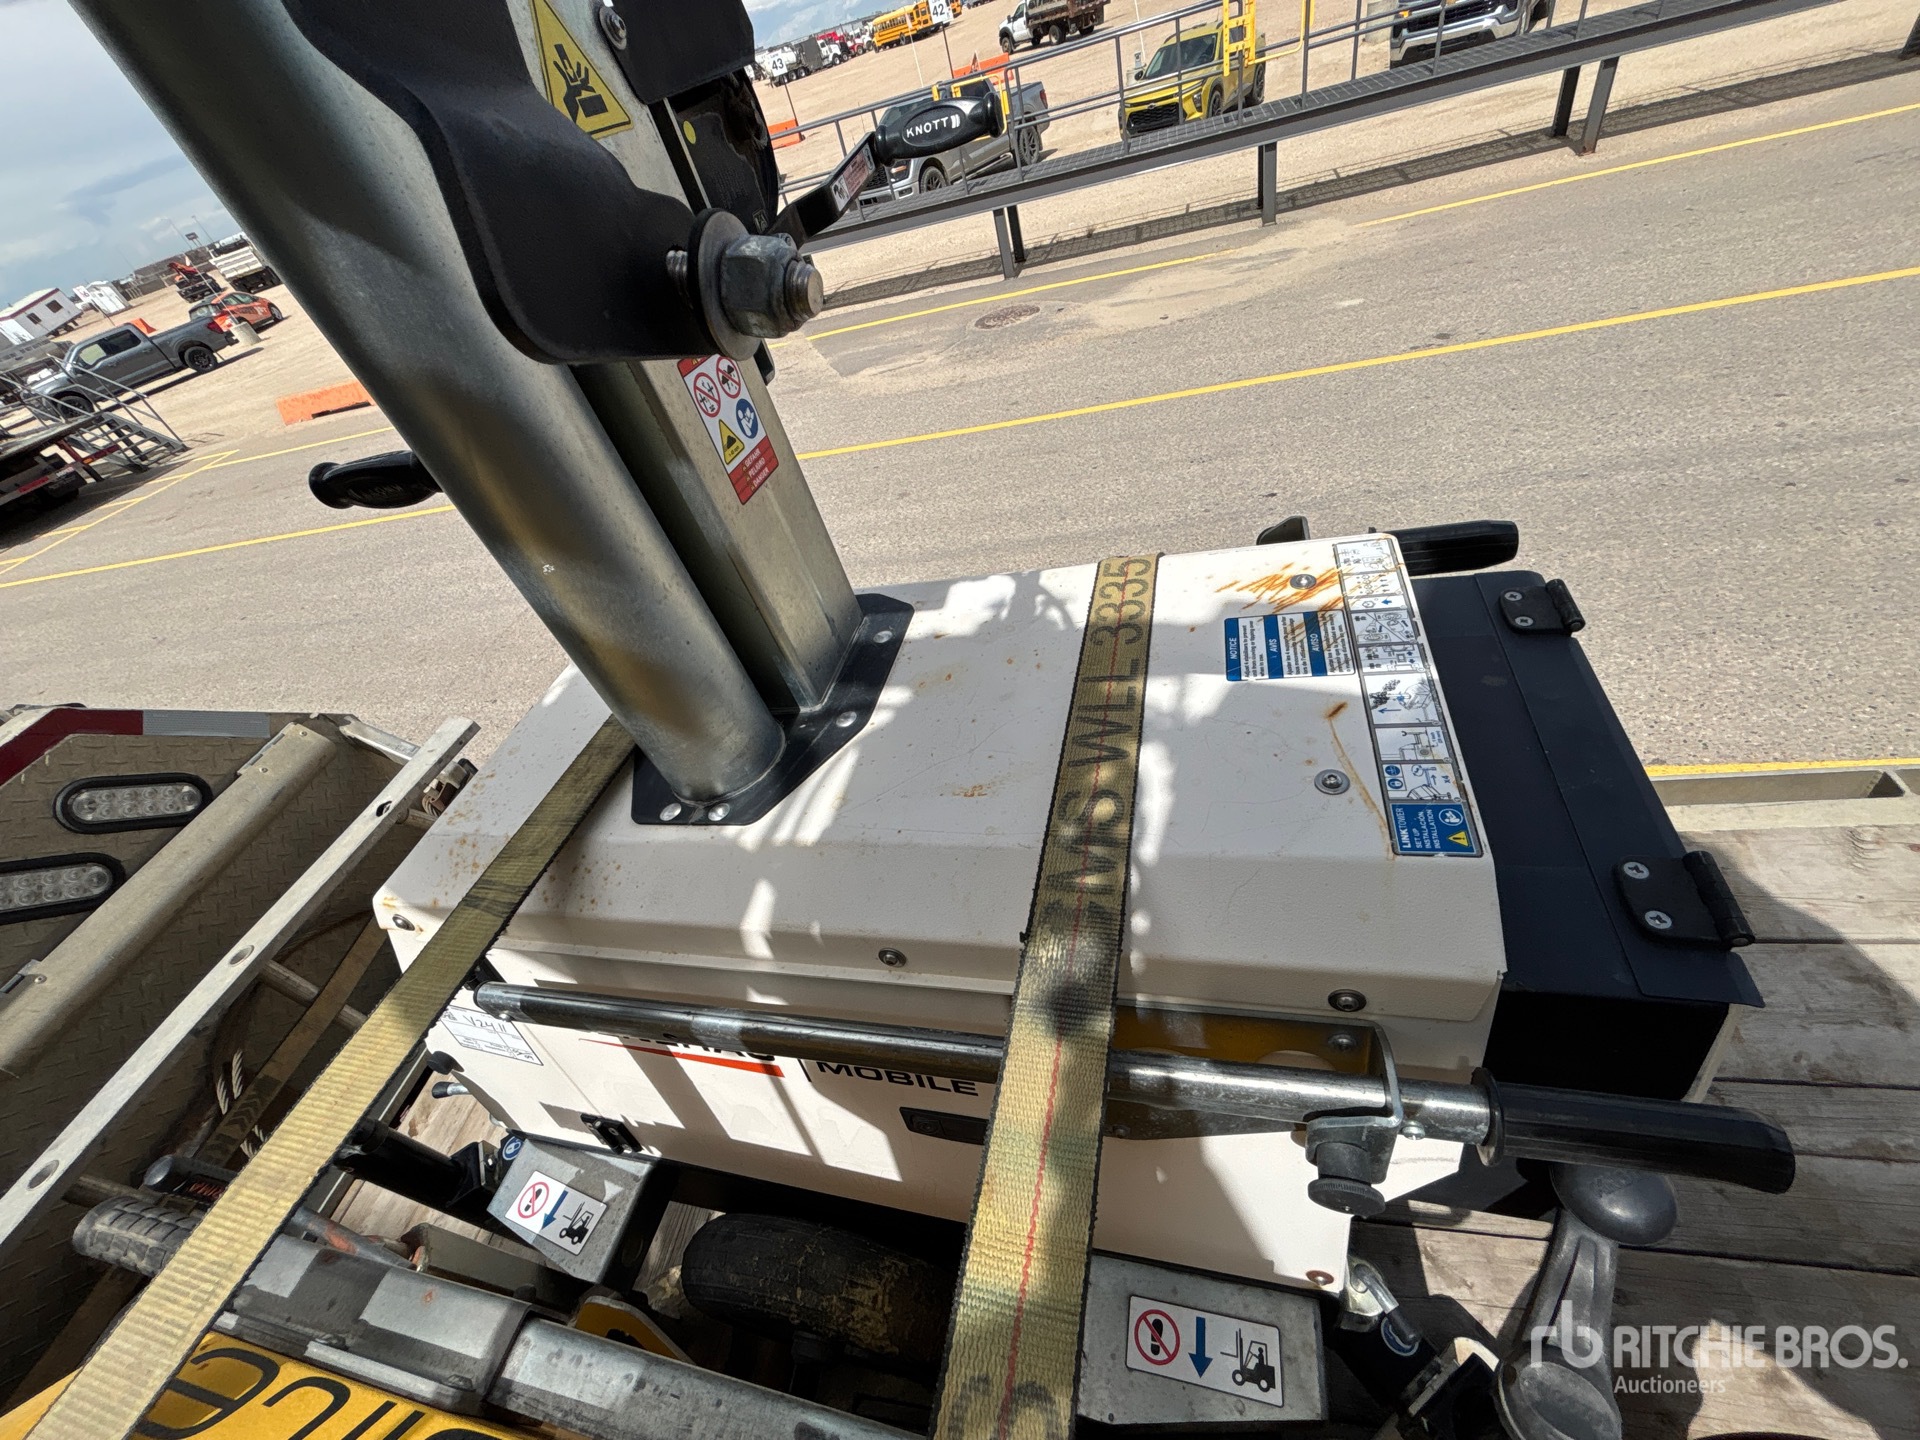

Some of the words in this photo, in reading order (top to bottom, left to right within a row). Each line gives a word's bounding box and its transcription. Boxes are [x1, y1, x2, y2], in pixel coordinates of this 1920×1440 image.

[932, 4, 945, 16] 42
[772, 58, 784, 70] 43
[906, 116, 949, 139] KNOTT
[753, 466, 770, 488] DANGER
[1089, 558, 1152, 646] 3335
[1230, 637, 1238, 660] NOTICE
[1269, 639, 1278, 652] AVIS
[1310, 634, 1319, 651] AVISO
[1066, 657, 1140, 768] WLL
[1396, 807, 1411, 848] LINKTOWER
[1412, 827, 1419, 837] UP
[1415, 810, 1431, 849] INSTALACIÓN
[1426, 808, 1441, 849] INSTALLATION
[816, 1061, 979, 1097] MOBILE
